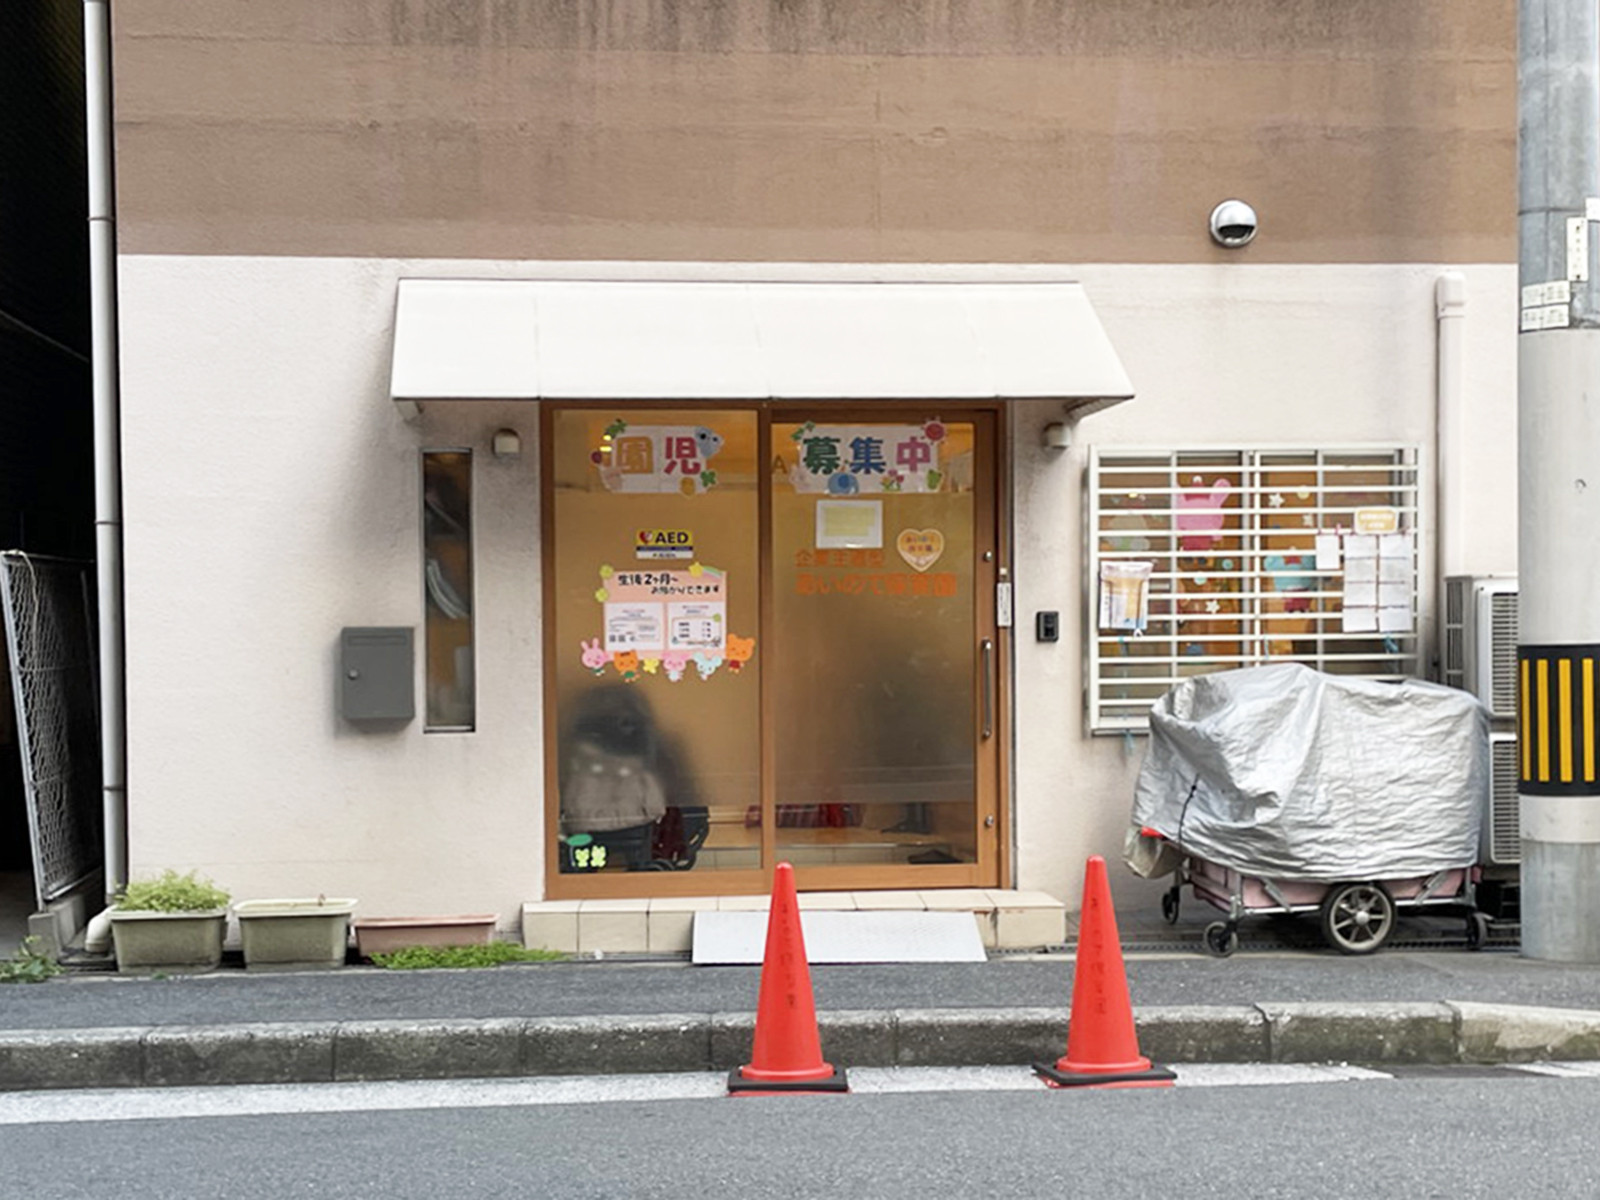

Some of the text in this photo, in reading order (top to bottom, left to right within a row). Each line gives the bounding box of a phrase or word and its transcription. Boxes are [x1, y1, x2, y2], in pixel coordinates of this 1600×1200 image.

[615, 435, 702, 475] 園児
[803, 435, 931, 475] 募集中
[655, 531, 689, 544] AED
